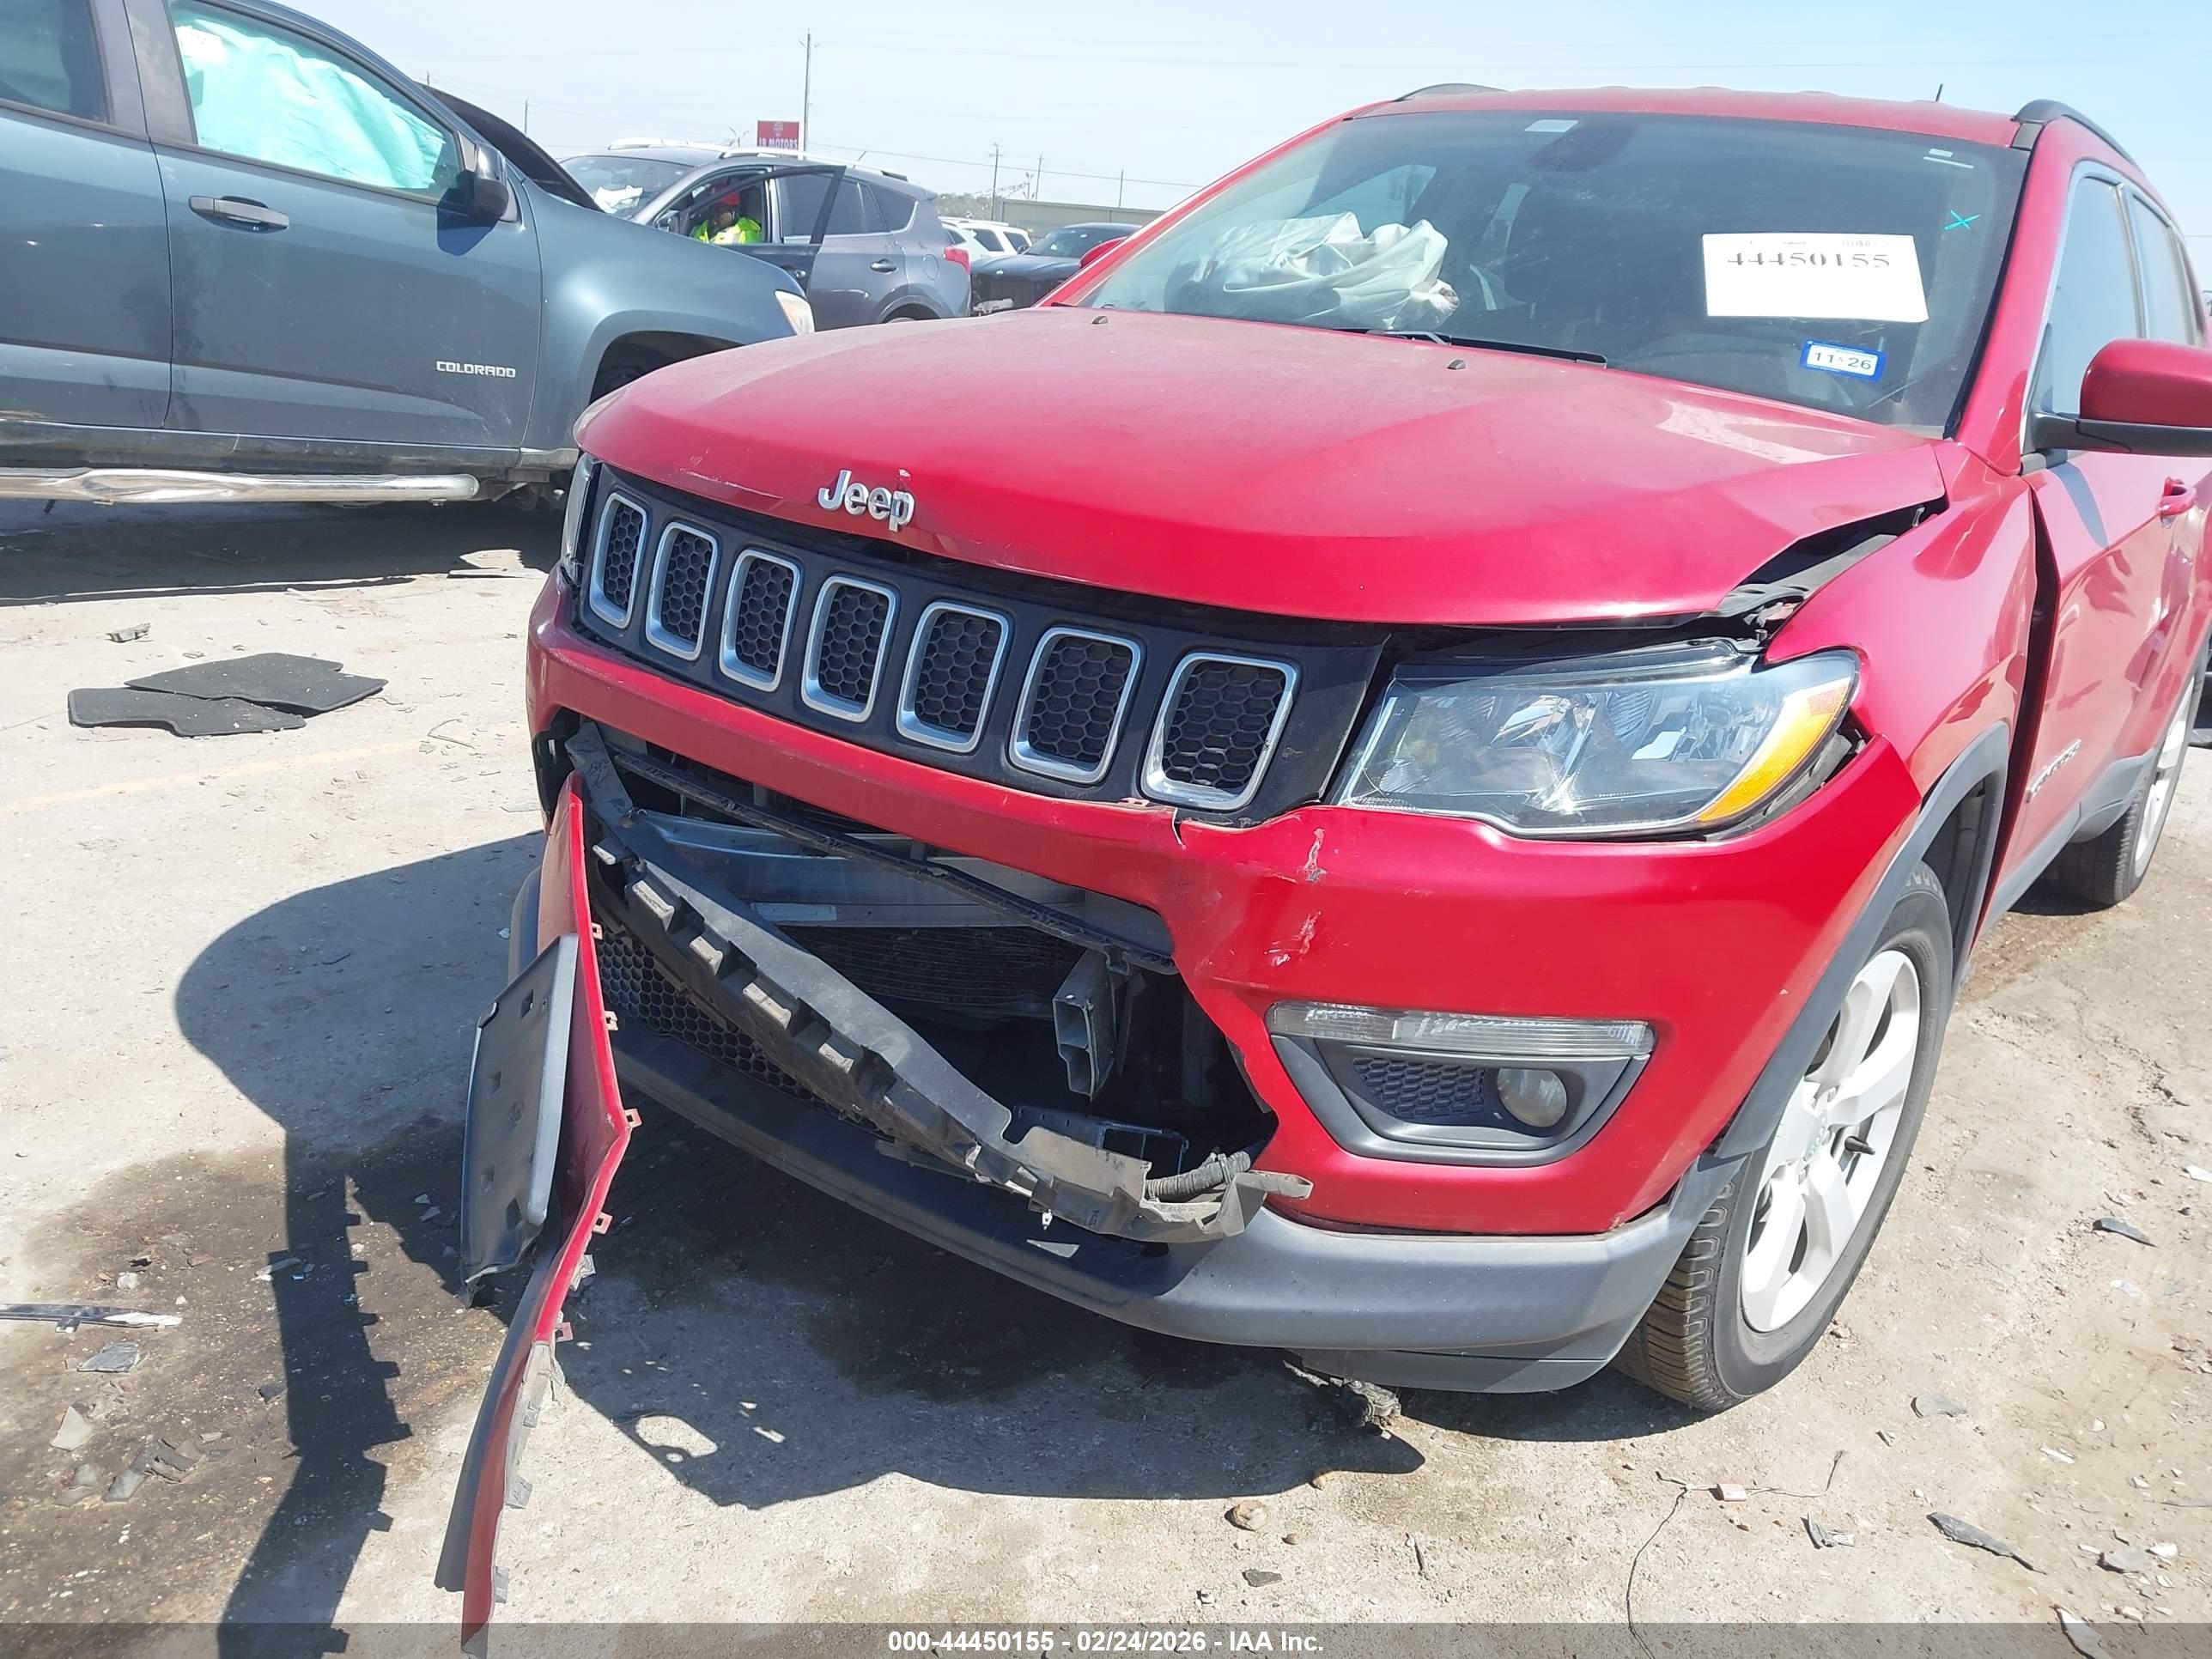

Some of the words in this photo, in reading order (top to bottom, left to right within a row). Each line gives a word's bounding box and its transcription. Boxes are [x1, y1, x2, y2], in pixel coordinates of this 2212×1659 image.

[769, 137, 798, 149] MOTORS
[1727, 252, 1890, 268] 44450155
[435, 361, 516, 379] COLORADO
[1814, 352, 1834, 363] 11
[1847, 357, 1872, 370] 26
[817, 469, 915, 533] Jeep
